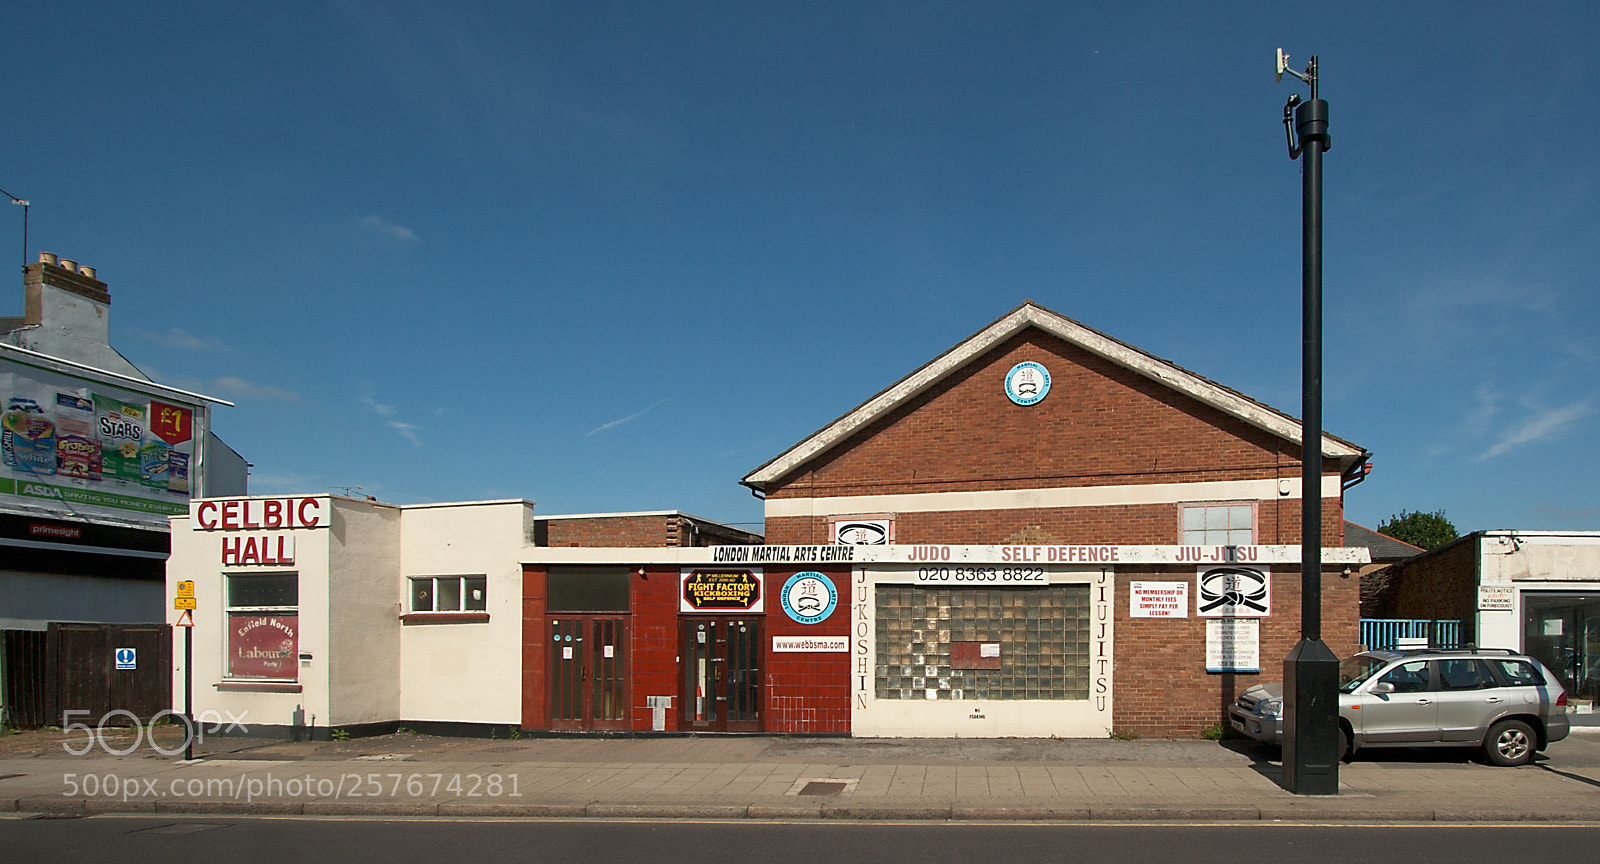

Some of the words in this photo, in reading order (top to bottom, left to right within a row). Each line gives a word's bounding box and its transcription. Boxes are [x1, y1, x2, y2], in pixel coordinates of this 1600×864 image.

[161, 408, 181, 431] £1
[100, 417, 140, 439] STARS
[23, 484, 62, 498] ASDA
[64, 491, 100, 501] SAVING
[103, 496, 118, 504] YOU
[121, 499, 147, 508] MONEY
[150, 504, 173, 512] EVERY
[197, 498, 320, 529] CELBIC
[33, 525, 79, 537] primesight
[222, 535, 294, 564] HALL
[714, 547, 749, 562] LONDON
[751, 547, 790, 562] MARTIAL
[793, 547, 817, 562] ARTS
[820, 546, 854, 561] CENTRE
[908, 547, 951, 561] JUDO
[1001, 547, 1041, 562] SELF
[1047, 547, 1119, 562] DEFENCE
[1175, 547, 1257, 562] JIU-JITSU
[918, 568, 950, 581] 020
[955, 568, 997, 581] 8363
[1002, 568, 1044, 581] 8822
[688, 583, 715, 591] FIGHT
[717, 583, 756, 591] FACTORY
[782, 585, 790, 610] LONDON
[238, 617, 267, 636] Enfield
[270, 618, 293, 637] North
[776, 640, 845, 650] www.webbsma.com
[239, 647, 281, 659] Labour
